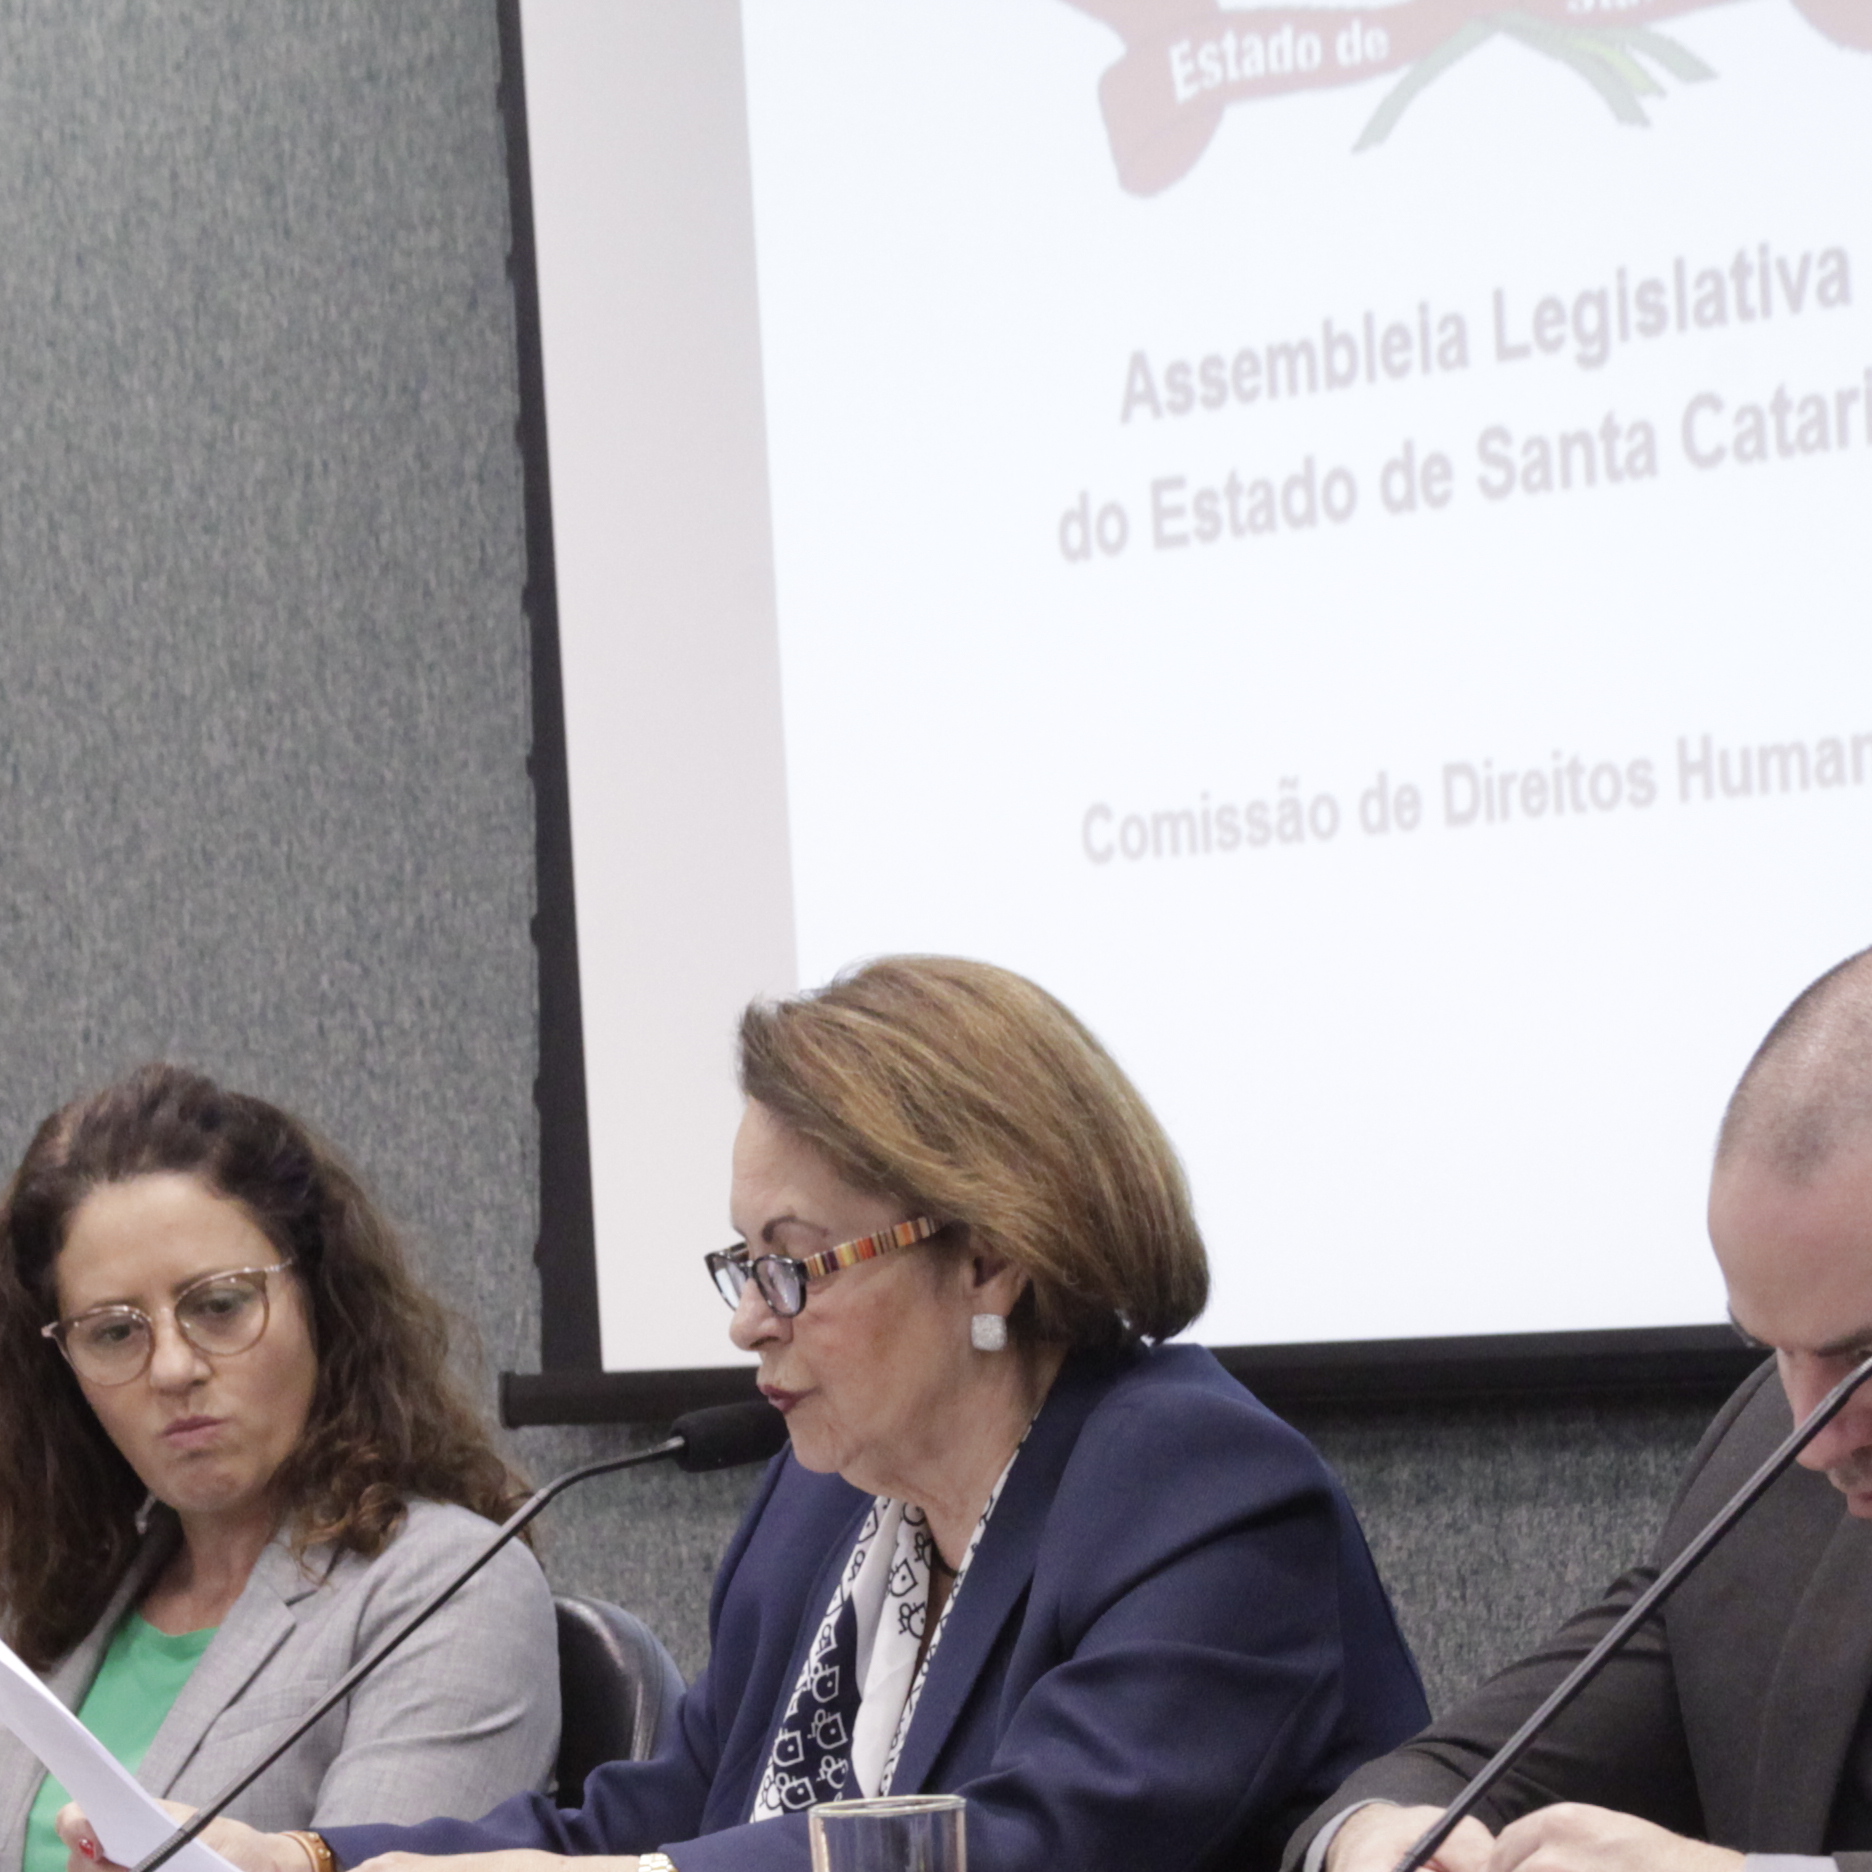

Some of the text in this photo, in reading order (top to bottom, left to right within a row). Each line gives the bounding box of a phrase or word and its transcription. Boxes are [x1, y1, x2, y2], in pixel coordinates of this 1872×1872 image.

[1168, 19, 1389, 104] Estado de
[1119, 242, 1854, 426] Assembleia Legislativa
[1058, 489, 1130, 564] do
[1149, 454, 1359, 551] Estado
[1379, 438, 1455, 516] de
[1476, 409, 1660, 502] Santa
[1081, 776, 1341, 866] Comissão
[1358, 770, 1423, 837] de
[1441, 750, 1658, 828] Direitos
